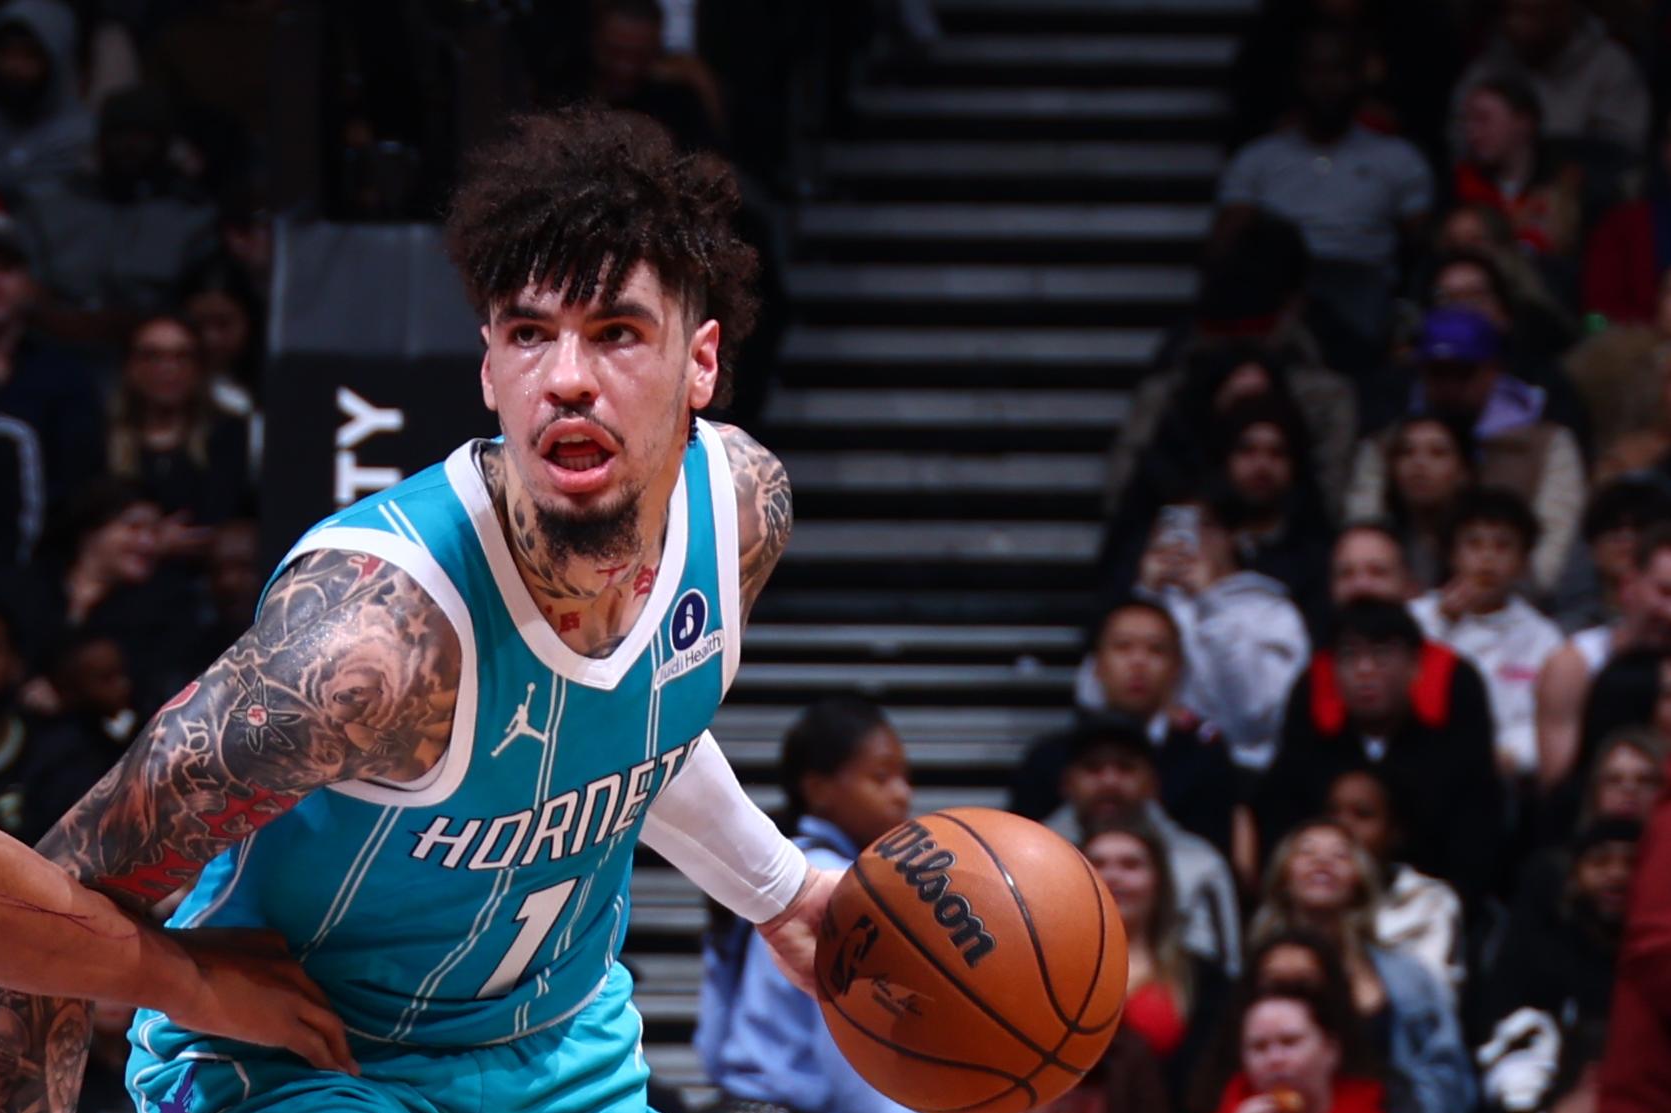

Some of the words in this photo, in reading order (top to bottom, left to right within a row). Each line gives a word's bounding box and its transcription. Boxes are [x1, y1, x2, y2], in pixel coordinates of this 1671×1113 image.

[685, 634, 721, 668] Health
[406, 735, 701, 872] HORNET
[473, 876, 580, 1001] 1
[874, 820, 996, 967] Wilson
